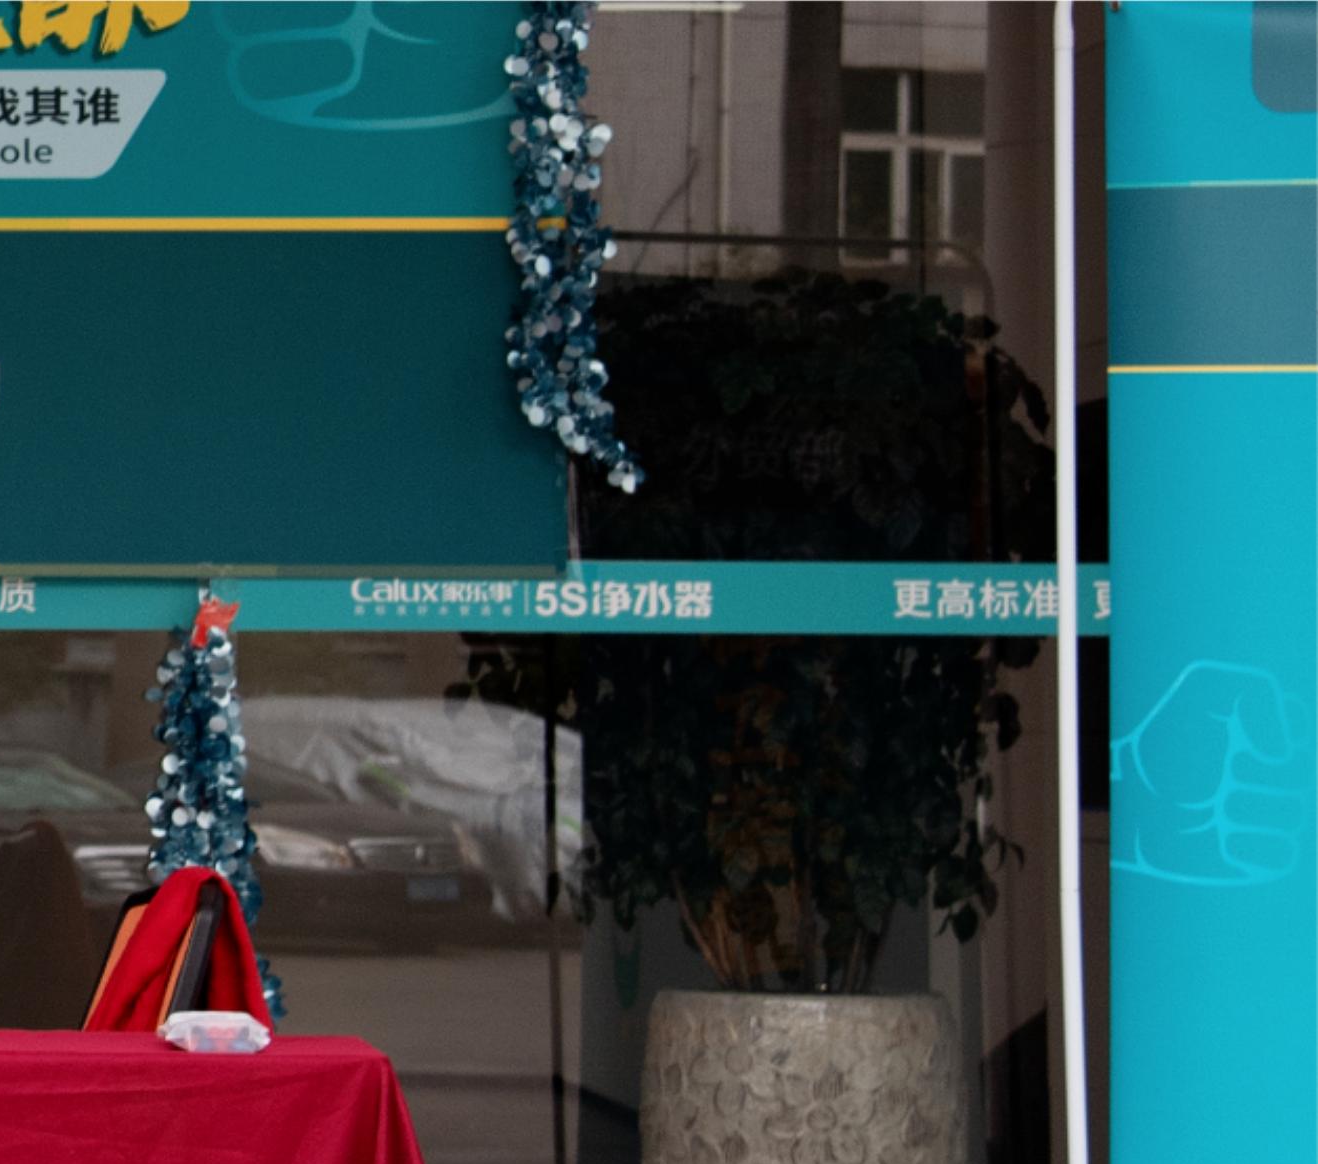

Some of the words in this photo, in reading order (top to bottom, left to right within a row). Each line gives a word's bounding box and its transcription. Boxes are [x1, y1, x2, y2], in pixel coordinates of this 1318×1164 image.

[534, 581, 713, 618] 5S净水器
[893, 579, 1060, 619] 更高标准
